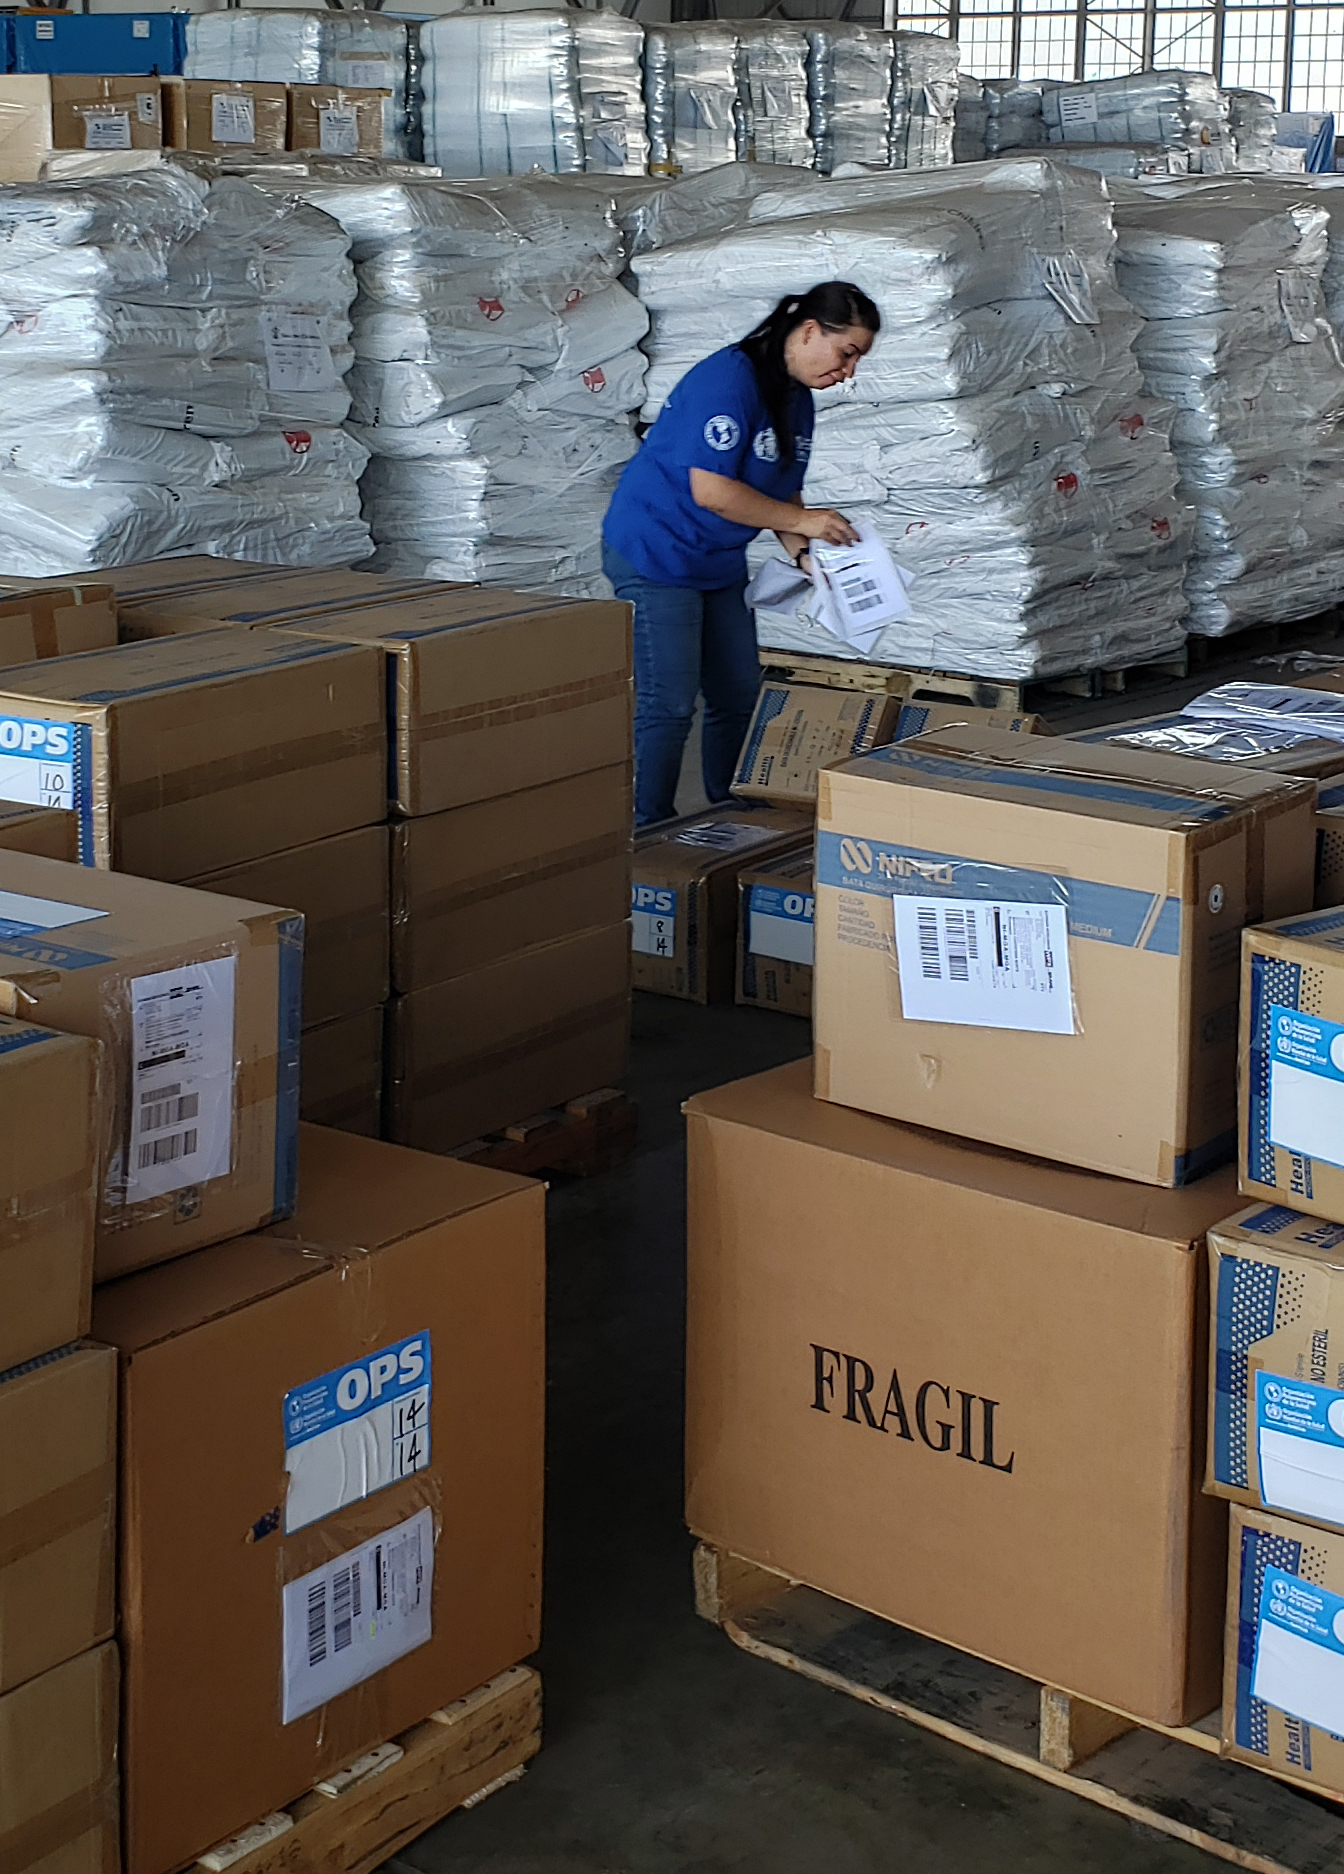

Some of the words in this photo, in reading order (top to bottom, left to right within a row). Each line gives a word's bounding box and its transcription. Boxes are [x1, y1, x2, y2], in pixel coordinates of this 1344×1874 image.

[44, 772, 65, 791] 10
[632, 888, 672, 911] PS
[783, 894, 815, 918] OP
[1289, 1150, 1304, 1195] Heal
[1294, 1221, 1341, 1245] Hea
[1313, 1328, 1328, 1367] ESTERIL
[336, 1340, 424, 1411] OPS
[1311, 1366, 1324, 1384] NO
[399, 1398, 425, 1438] 14
[810, 1343, 1015, 1474] FRAGIL
[399, 1433, 421, 1476] 14
[1285, 1711, 1301, 1766] Healt
